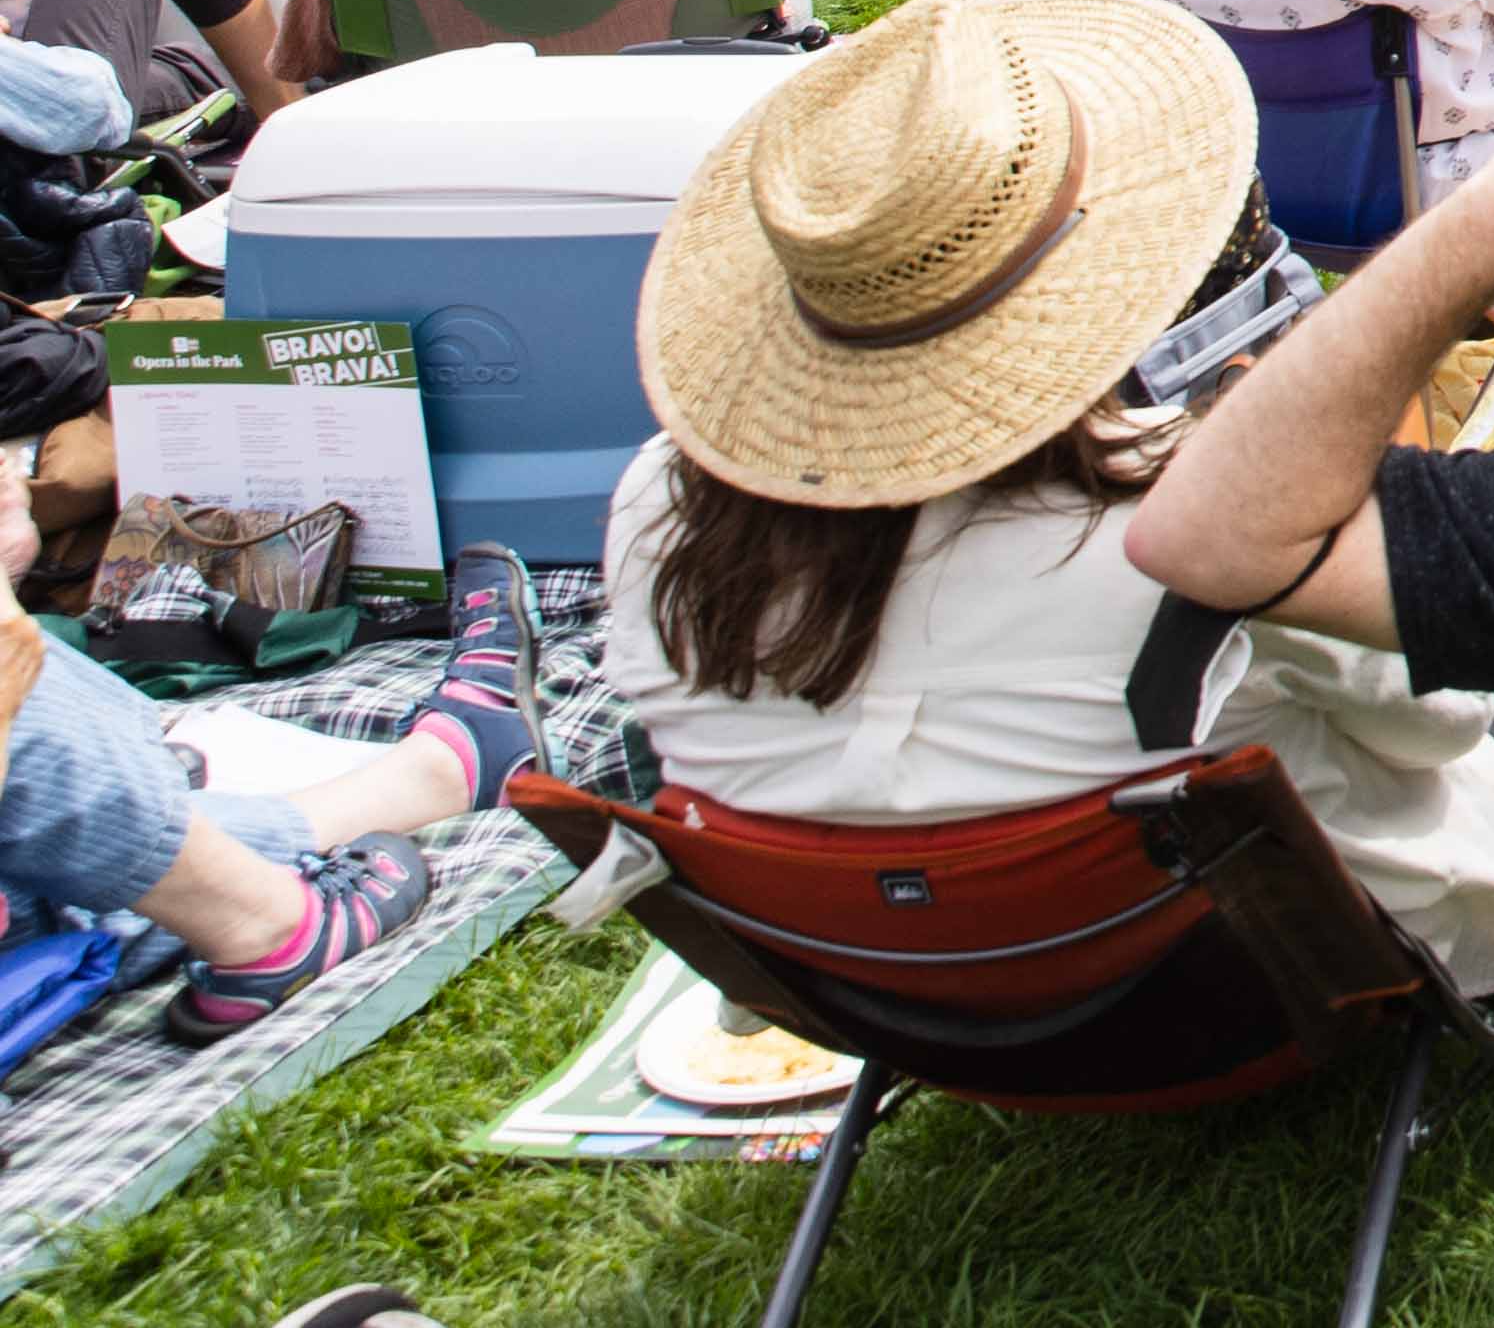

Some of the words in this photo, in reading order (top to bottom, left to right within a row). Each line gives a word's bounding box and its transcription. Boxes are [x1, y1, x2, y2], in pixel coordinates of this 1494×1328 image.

[269, 328, 376, 363] BRAVO!
[132, 355, 172, 371] Opera
[175, 353, 190, 368] in
[191, 354, 211, 369] the
[211, 354, 243, 368] Park
[293, 354, 400, 386] BRAVA!
